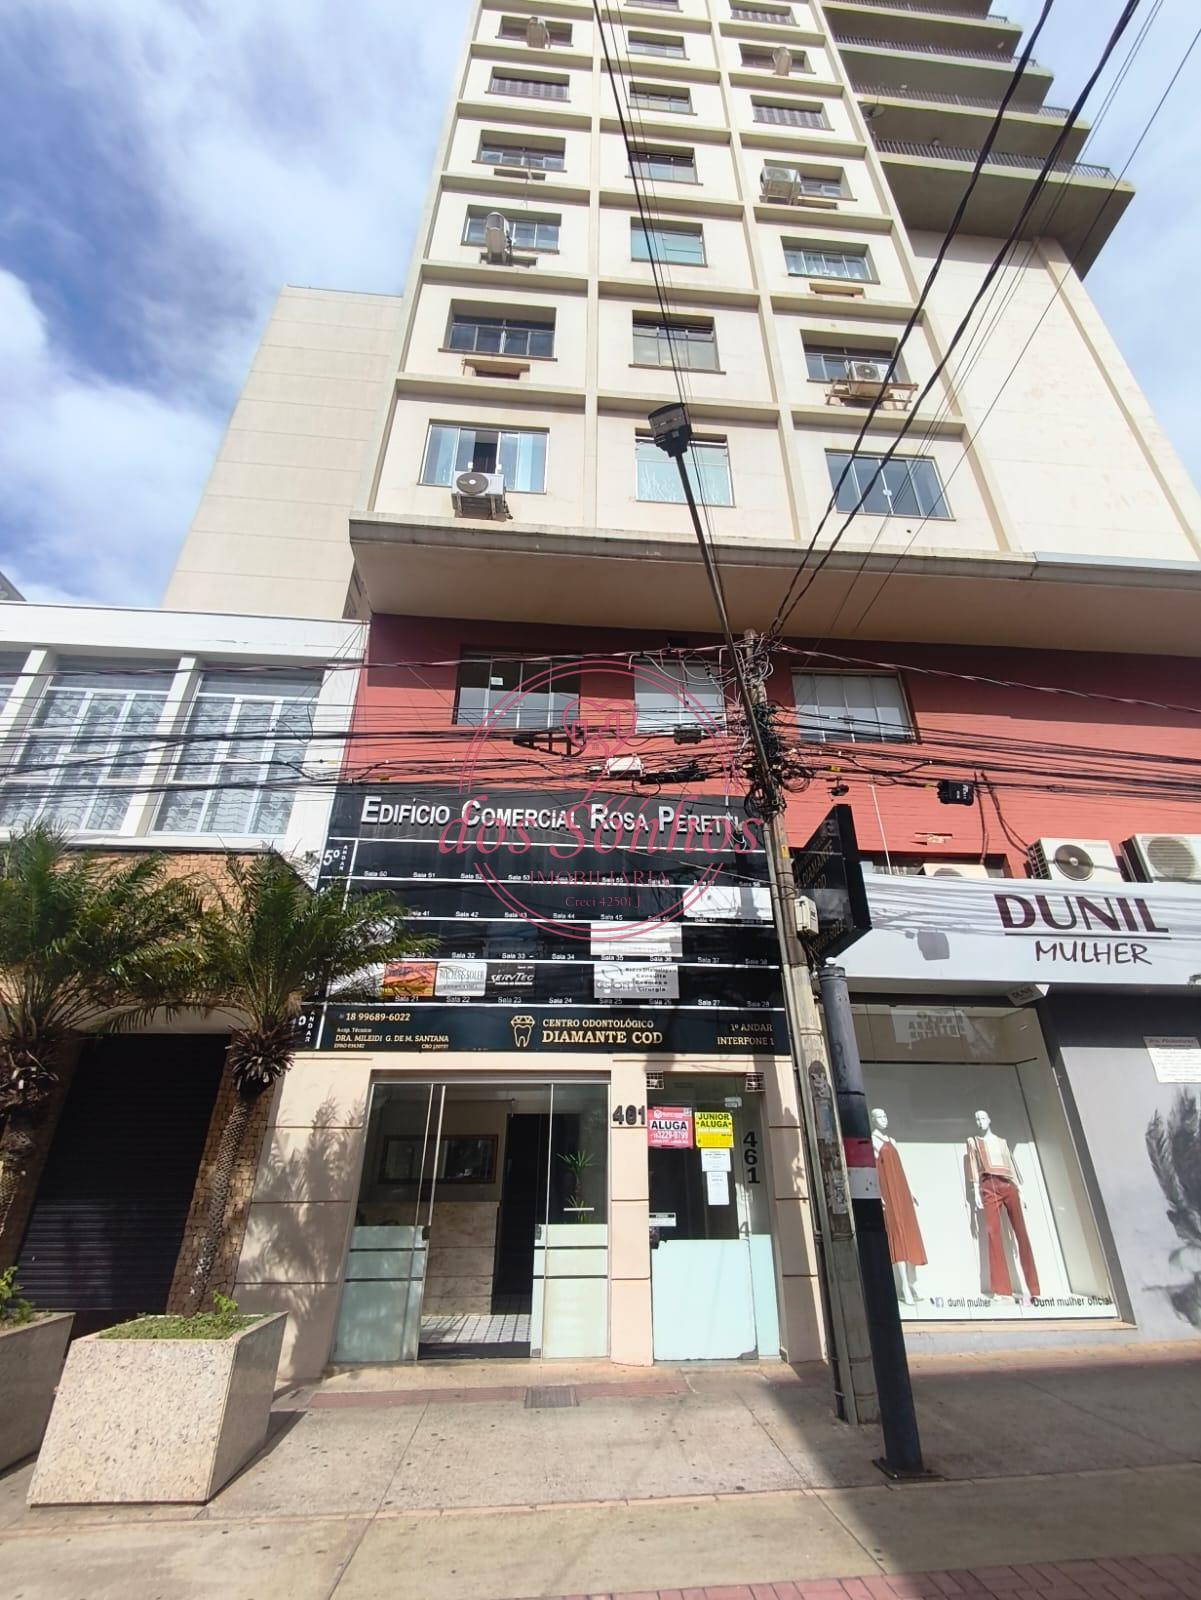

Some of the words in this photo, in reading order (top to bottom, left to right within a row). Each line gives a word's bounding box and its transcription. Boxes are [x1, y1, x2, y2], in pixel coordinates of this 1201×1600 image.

[590, 804, 649, 832] ROSA
[994, 893, 1169, 933] DUNIL
[1035, 940, 1152, 965] MULHER
[346, 1013, 356, 1021] 18
[358, 1013, 411, 1021] 99689-6022
[543, 1019, 580, 1027] CENTRO
[582, 1018, 654, 1028] ODONTOLÓGICO
[741, 1023, 773, 1032] ANDAR
[542, 1030, 627, 1043] DIAMANTE
[632, 1031, 663, 1044] COD
[717, 1036, 768, 1045] INTERFONE
[651, 1121, 687, 1130] ALUGA
[743, 1131, 760, 1184] 461
